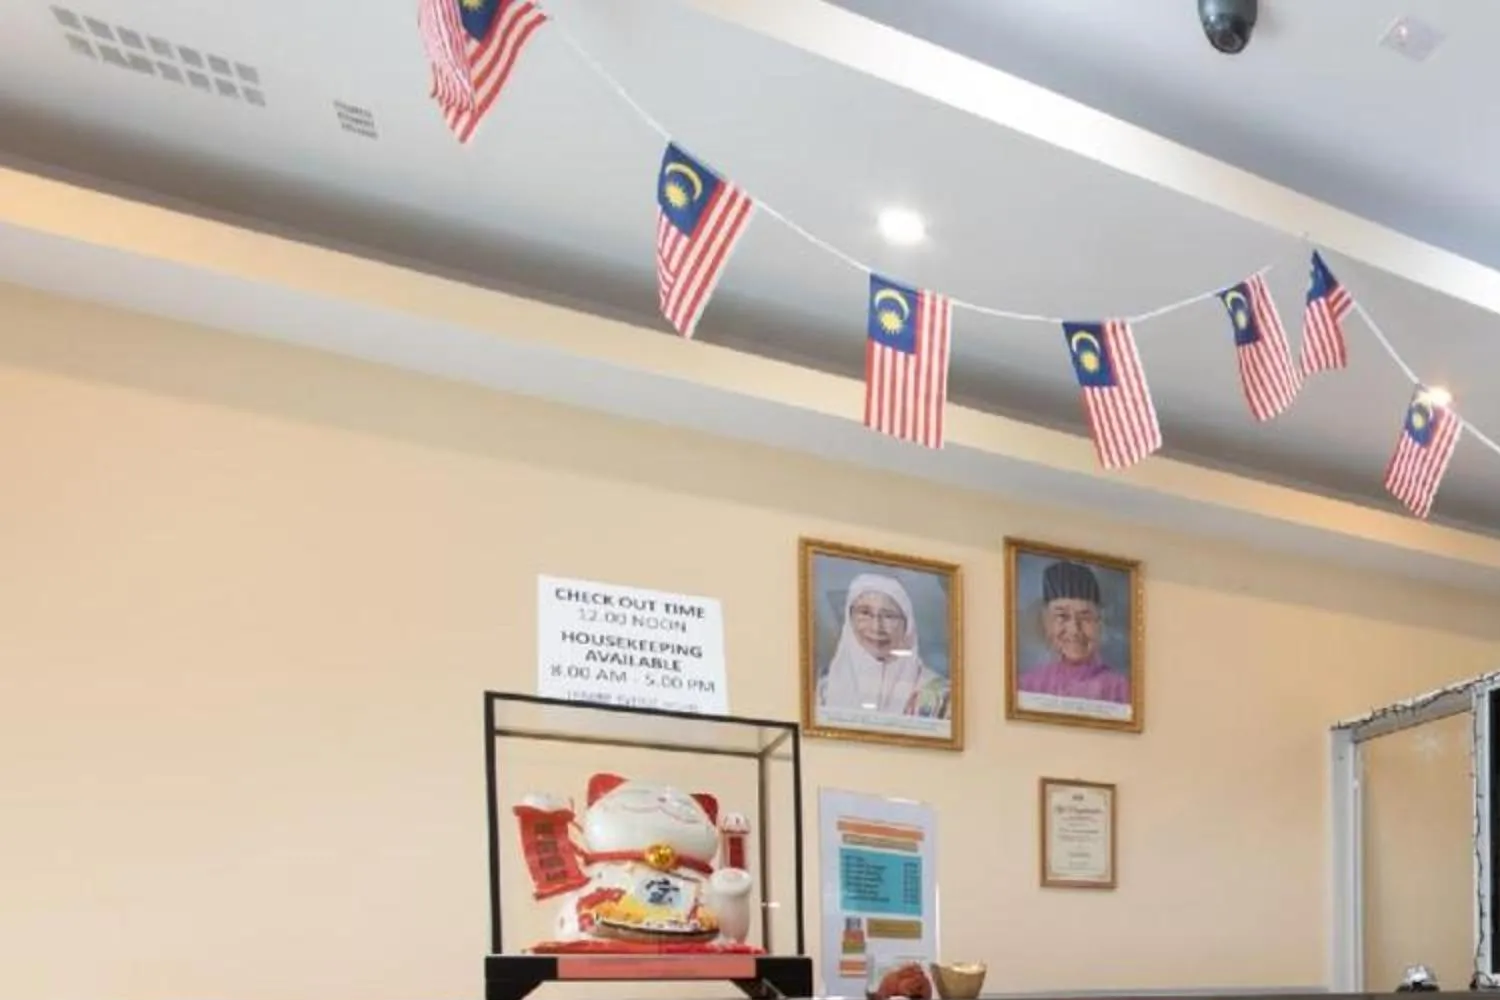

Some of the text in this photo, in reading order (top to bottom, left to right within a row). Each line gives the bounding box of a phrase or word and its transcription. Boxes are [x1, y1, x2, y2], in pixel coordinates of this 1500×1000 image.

[555, 587, 705, 619] CHECK OUT TIME
[579, 608, 687, 633] 12.00 NOON
[561, 630, 703, 659] HOUSEKEEPING
[585, 650, 683, 672] AVAILABLE
[596, 669, 627, 683] AM
[688, 678, 716, 694] PM
